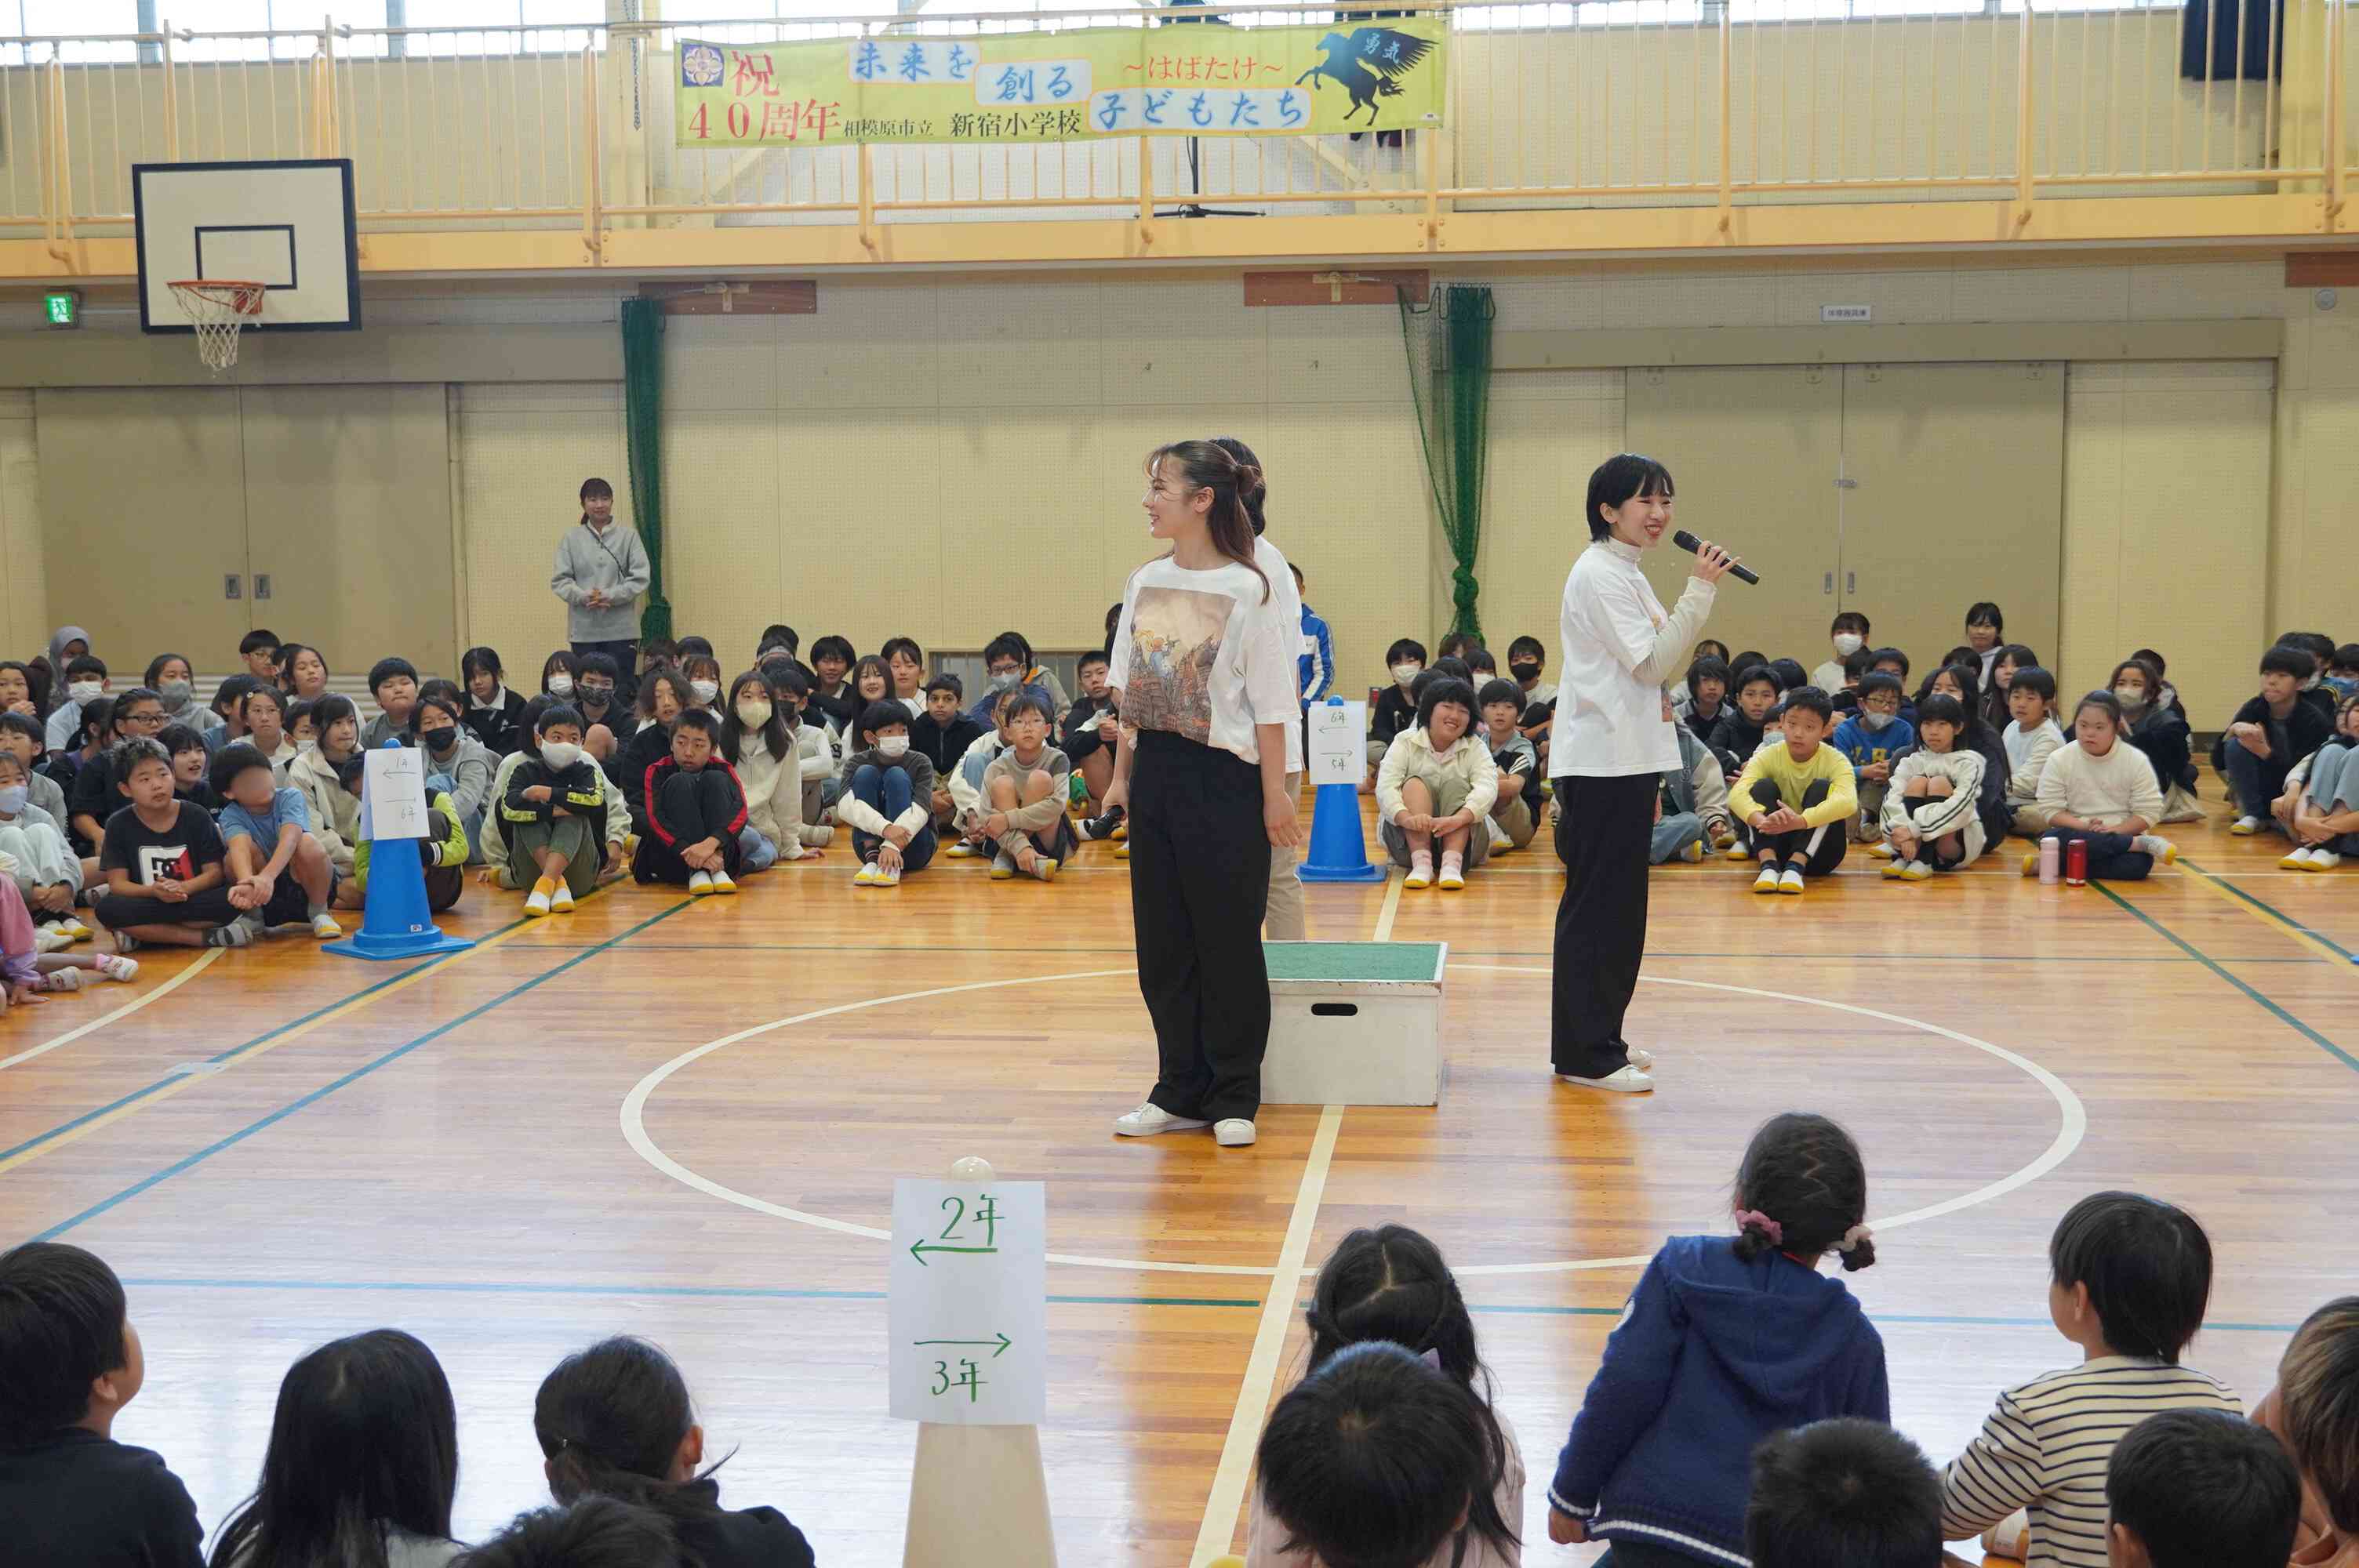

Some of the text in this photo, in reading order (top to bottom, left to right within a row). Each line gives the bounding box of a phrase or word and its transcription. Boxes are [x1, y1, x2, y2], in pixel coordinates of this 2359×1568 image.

[856, 42, 973, 82] 未来を
[1364, 33, 1401, 64] 勇気
[729, 50, 779, 96] 祝
[995, 65, 1074, 102] 創る
[689, 99, 841, 141] 40周年
[843, 110, 1080, 137] 相模原市立 新宿小学校
[1098, 91, 1303, 130] 子どもたち
[940, 1193, 1005, 1246] 2年
[932, 1358, 988, 1403] 3年
